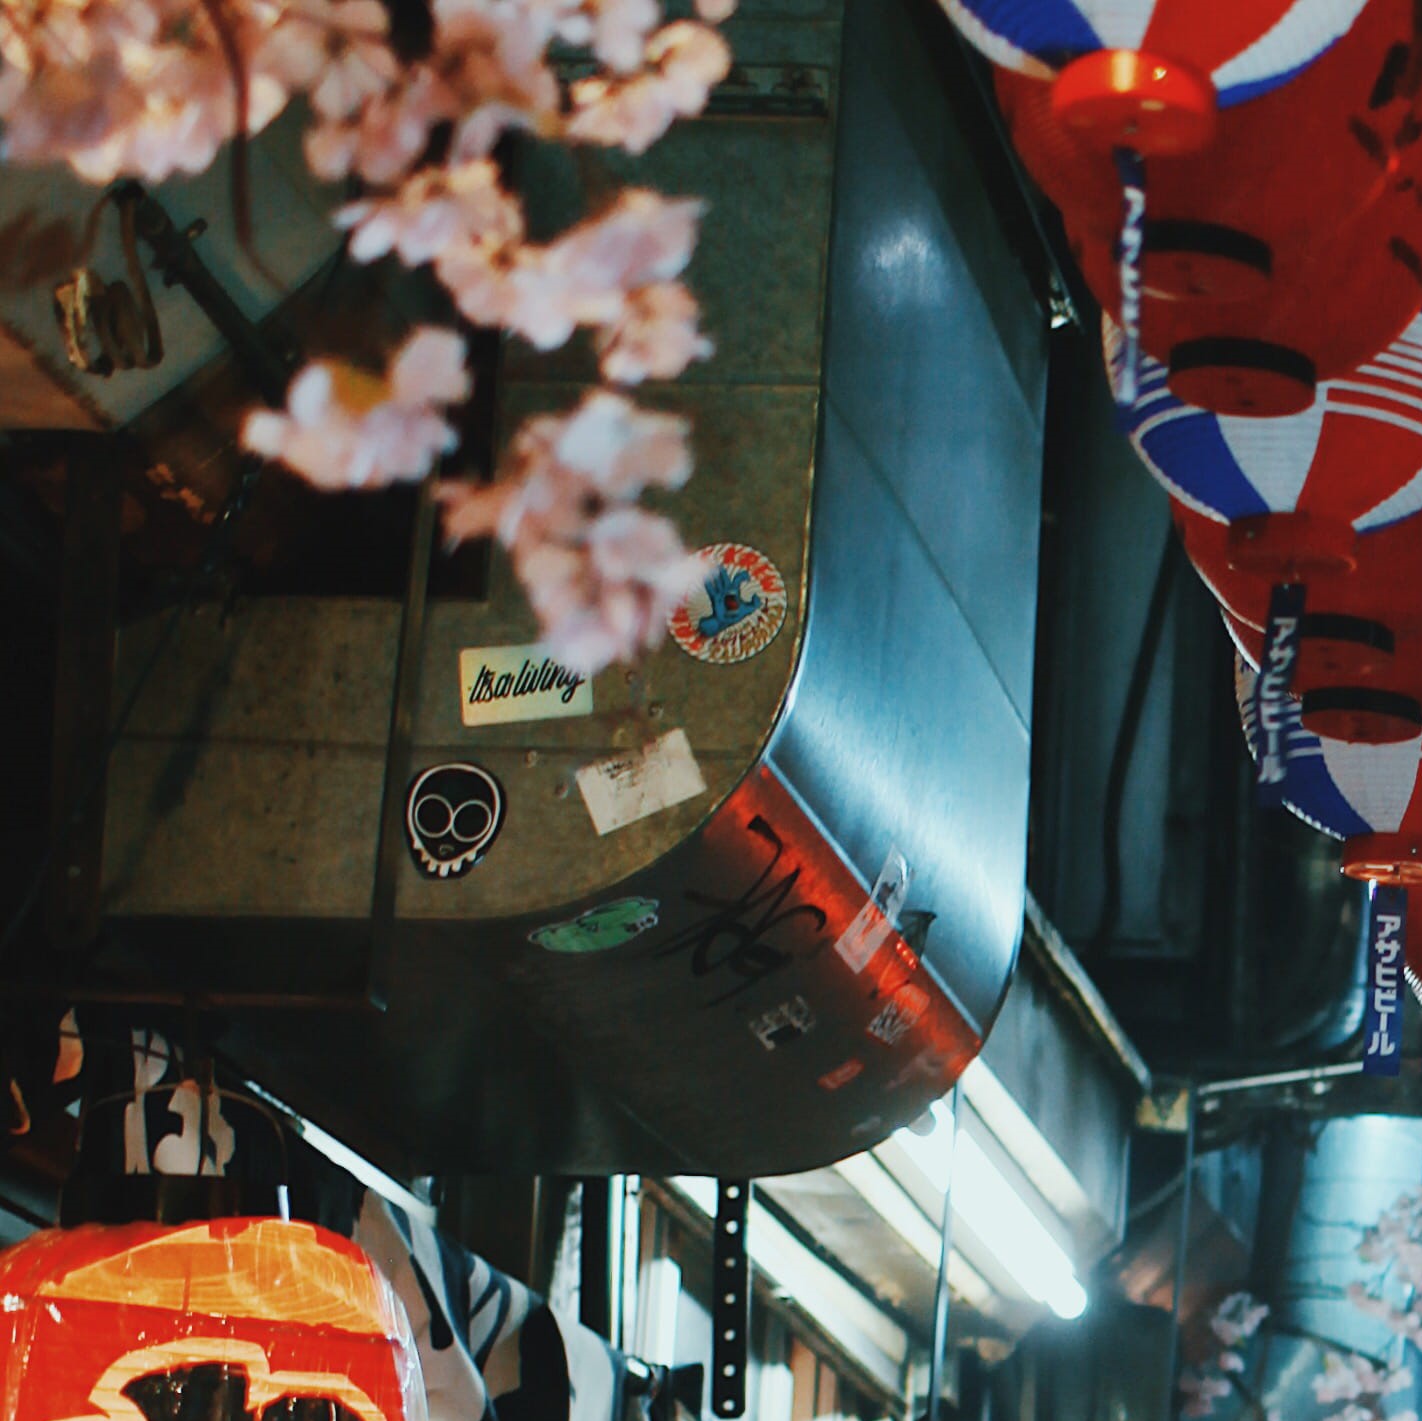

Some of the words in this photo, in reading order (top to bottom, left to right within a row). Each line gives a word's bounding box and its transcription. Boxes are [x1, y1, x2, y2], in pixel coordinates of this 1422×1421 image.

[1367, 914, 1401, 1056] アサヒビール
